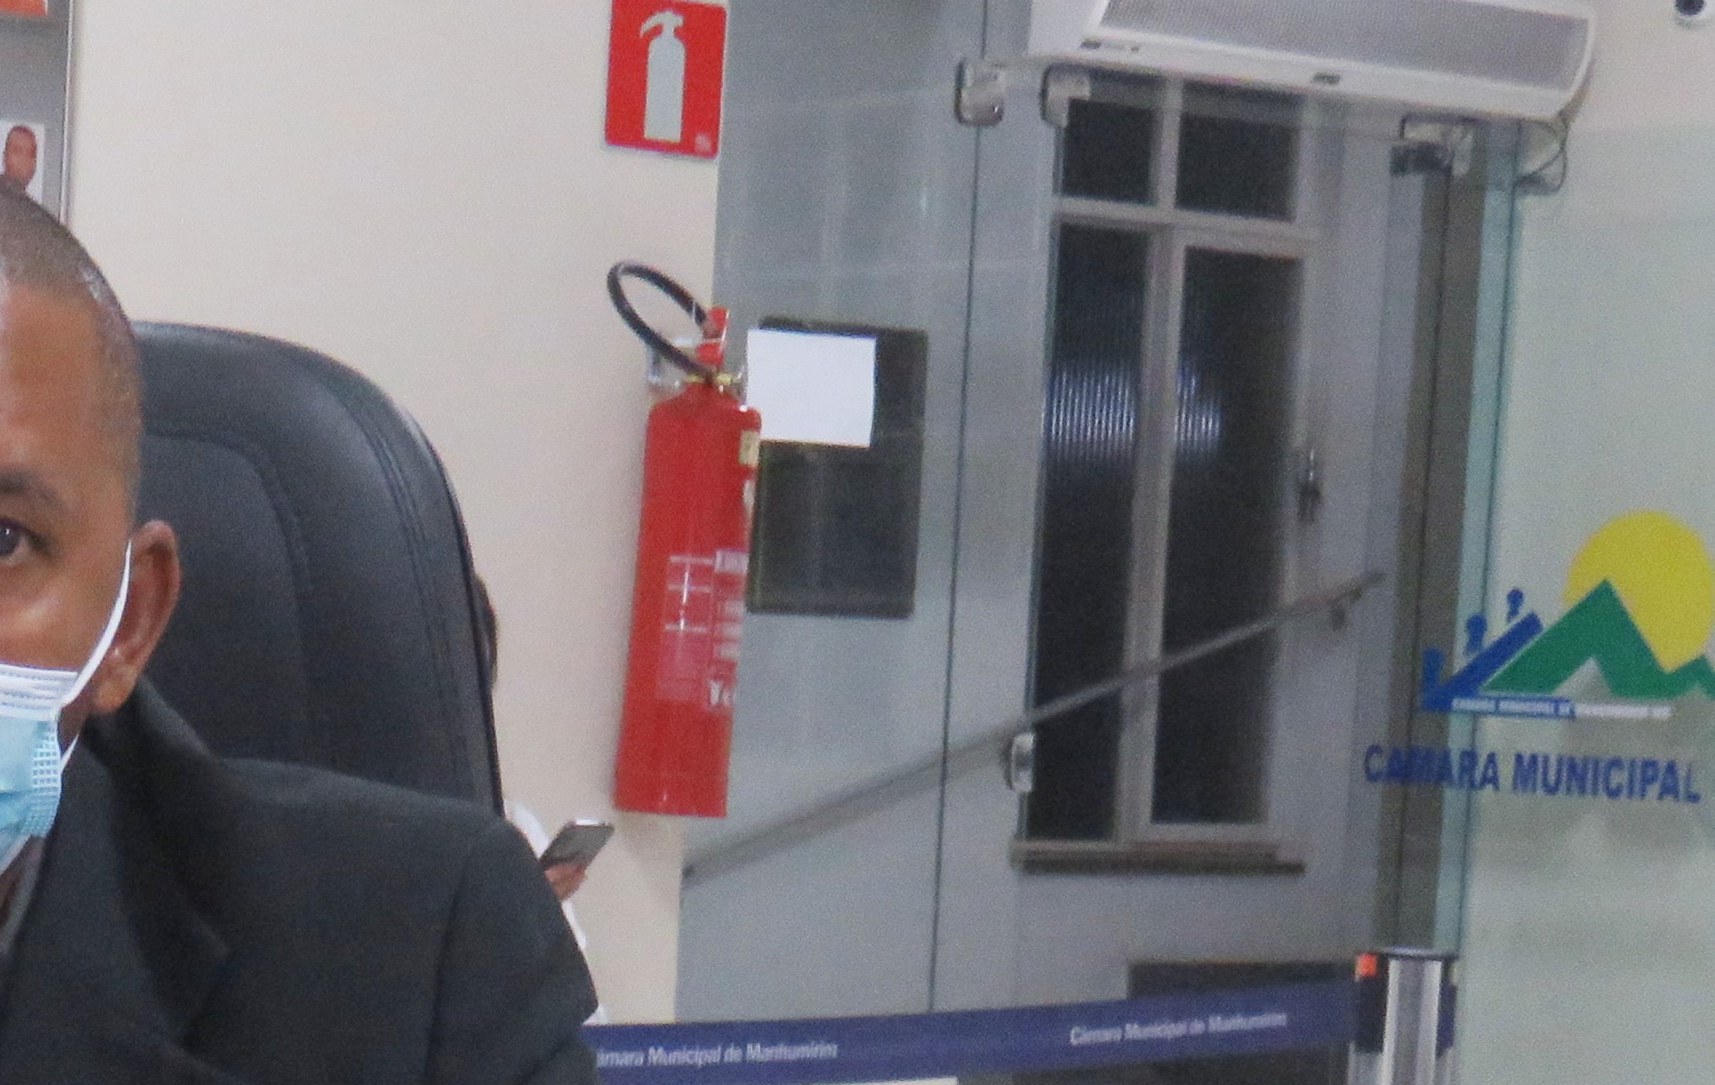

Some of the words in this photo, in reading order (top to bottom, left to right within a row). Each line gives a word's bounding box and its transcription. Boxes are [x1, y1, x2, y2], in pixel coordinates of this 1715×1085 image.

[1511, 751, 1702, 803] MUNICIPAL
[647, 1045, 722, 1067] Municipal
[724, 1044, 742, 1063] de
